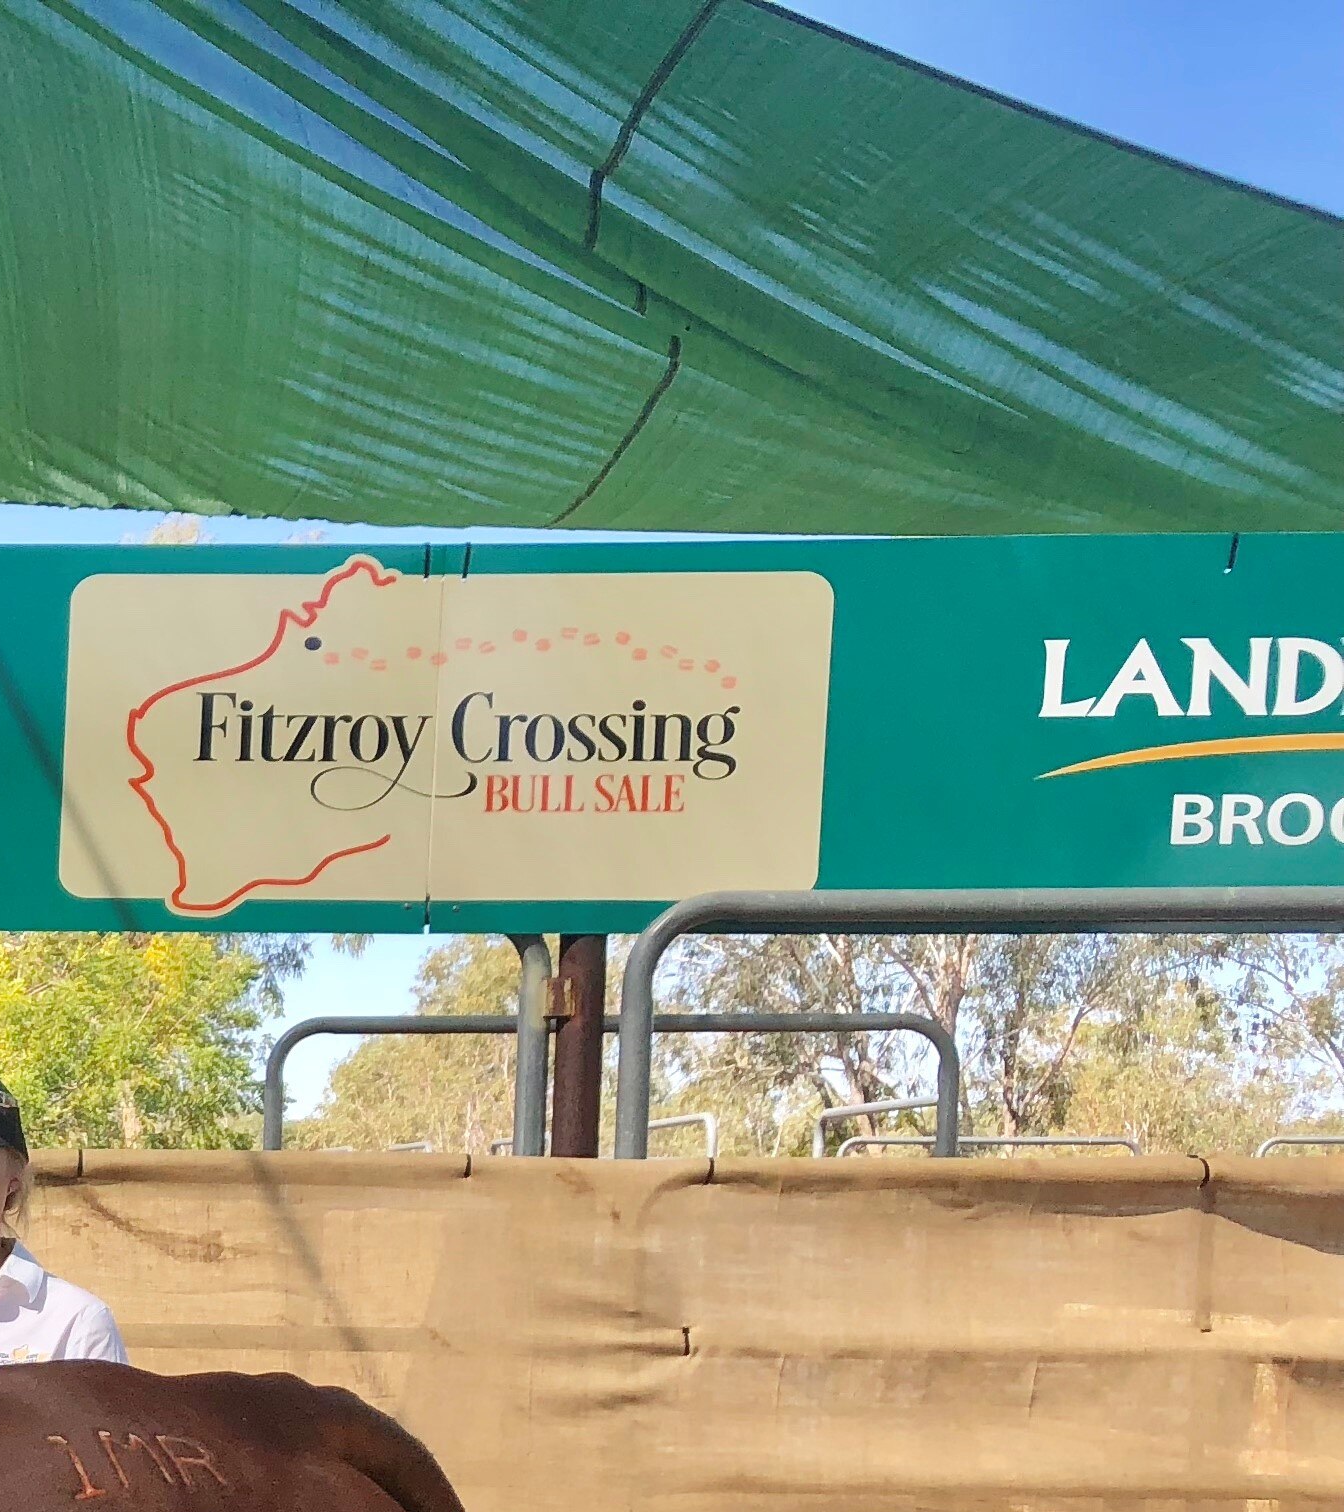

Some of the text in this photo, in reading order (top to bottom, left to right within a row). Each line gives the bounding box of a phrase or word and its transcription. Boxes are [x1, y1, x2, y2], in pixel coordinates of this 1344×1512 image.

[1037, 636, 1344, 719] LAND
[192, 690, 742, 811] Fitzroy Crossing
[483, 773, 687, 813] BULL SALE
[1169, 792, 1344, 846] BRO
